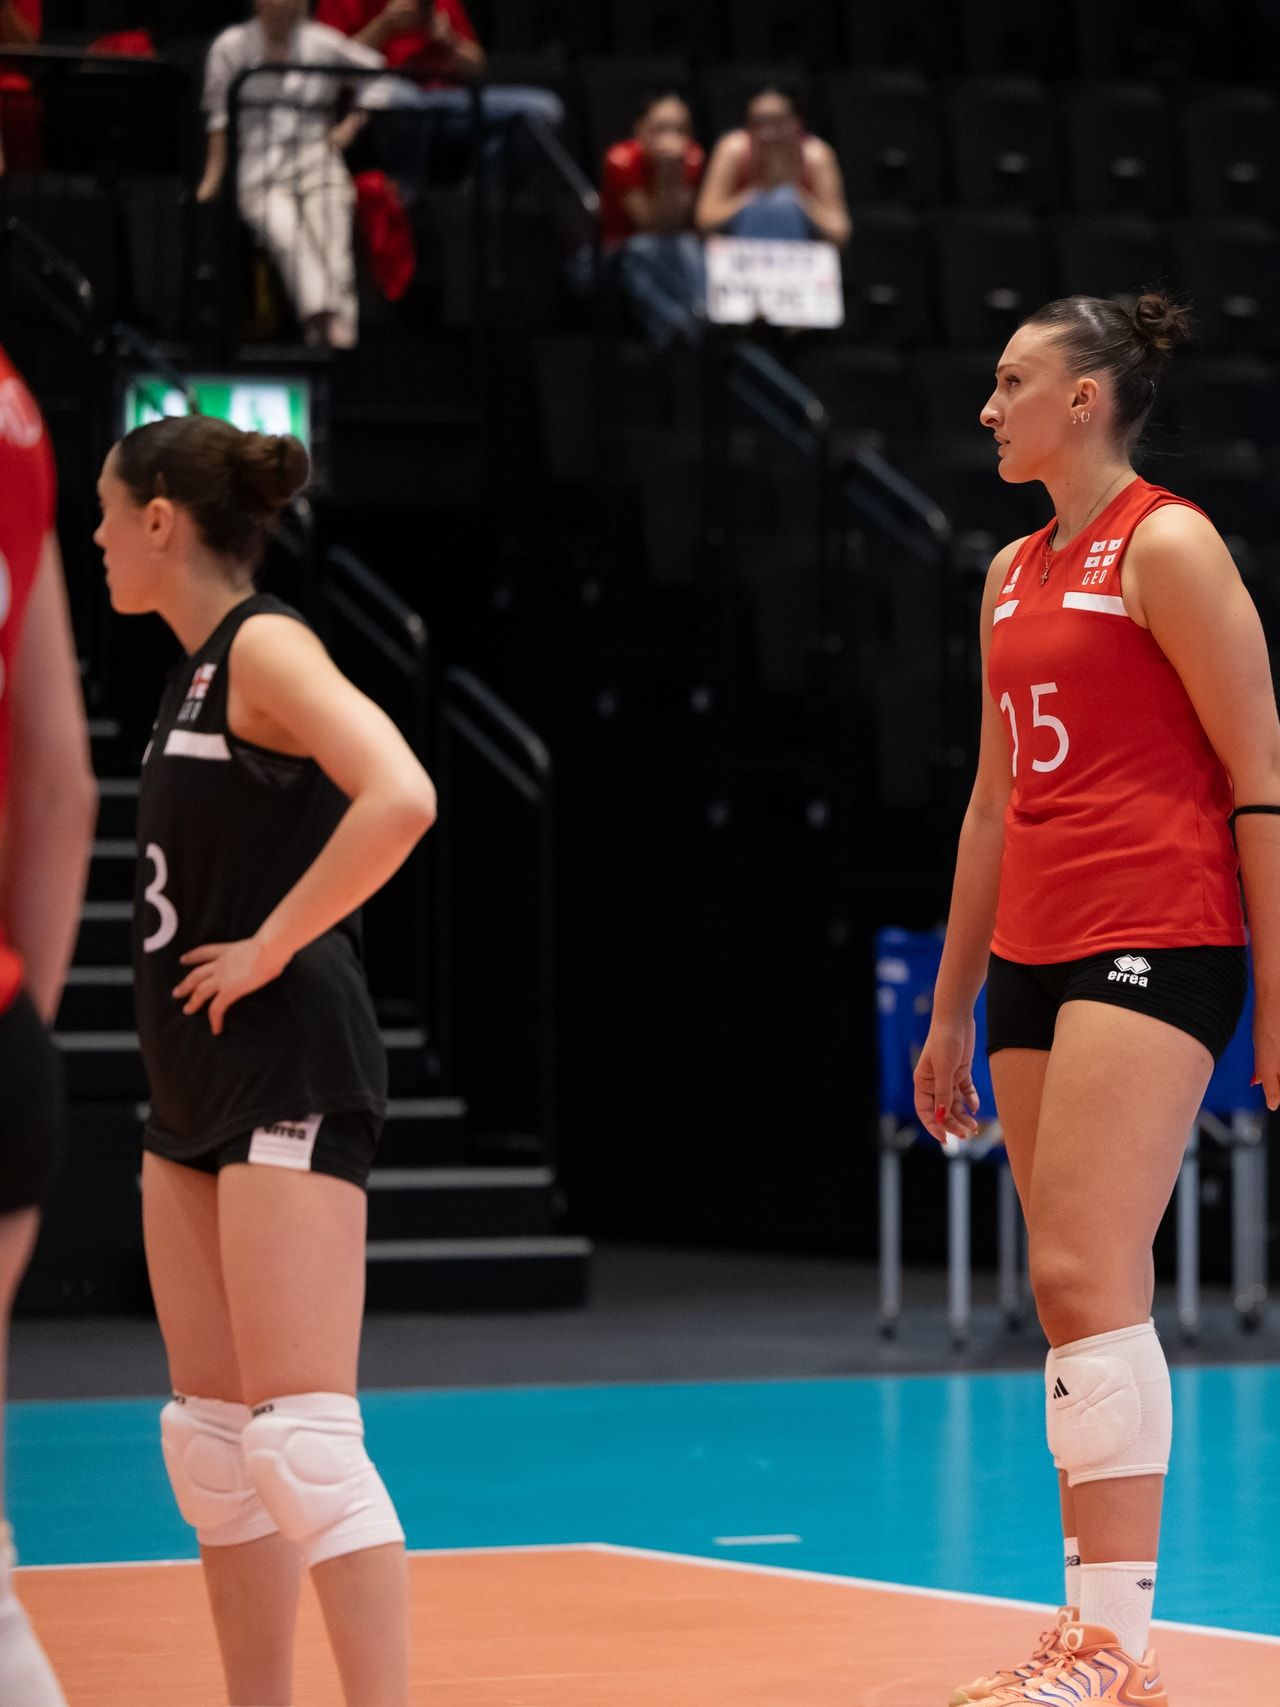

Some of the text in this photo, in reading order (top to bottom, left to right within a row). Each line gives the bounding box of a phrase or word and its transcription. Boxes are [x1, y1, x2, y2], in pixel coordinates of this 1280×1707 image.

[1081, 569, 1108, 586] GEO
[1000, 682, 1070, 778] 15
[143, 842, 179, 953] 3
[1107, 970, 1149, 988] errea
